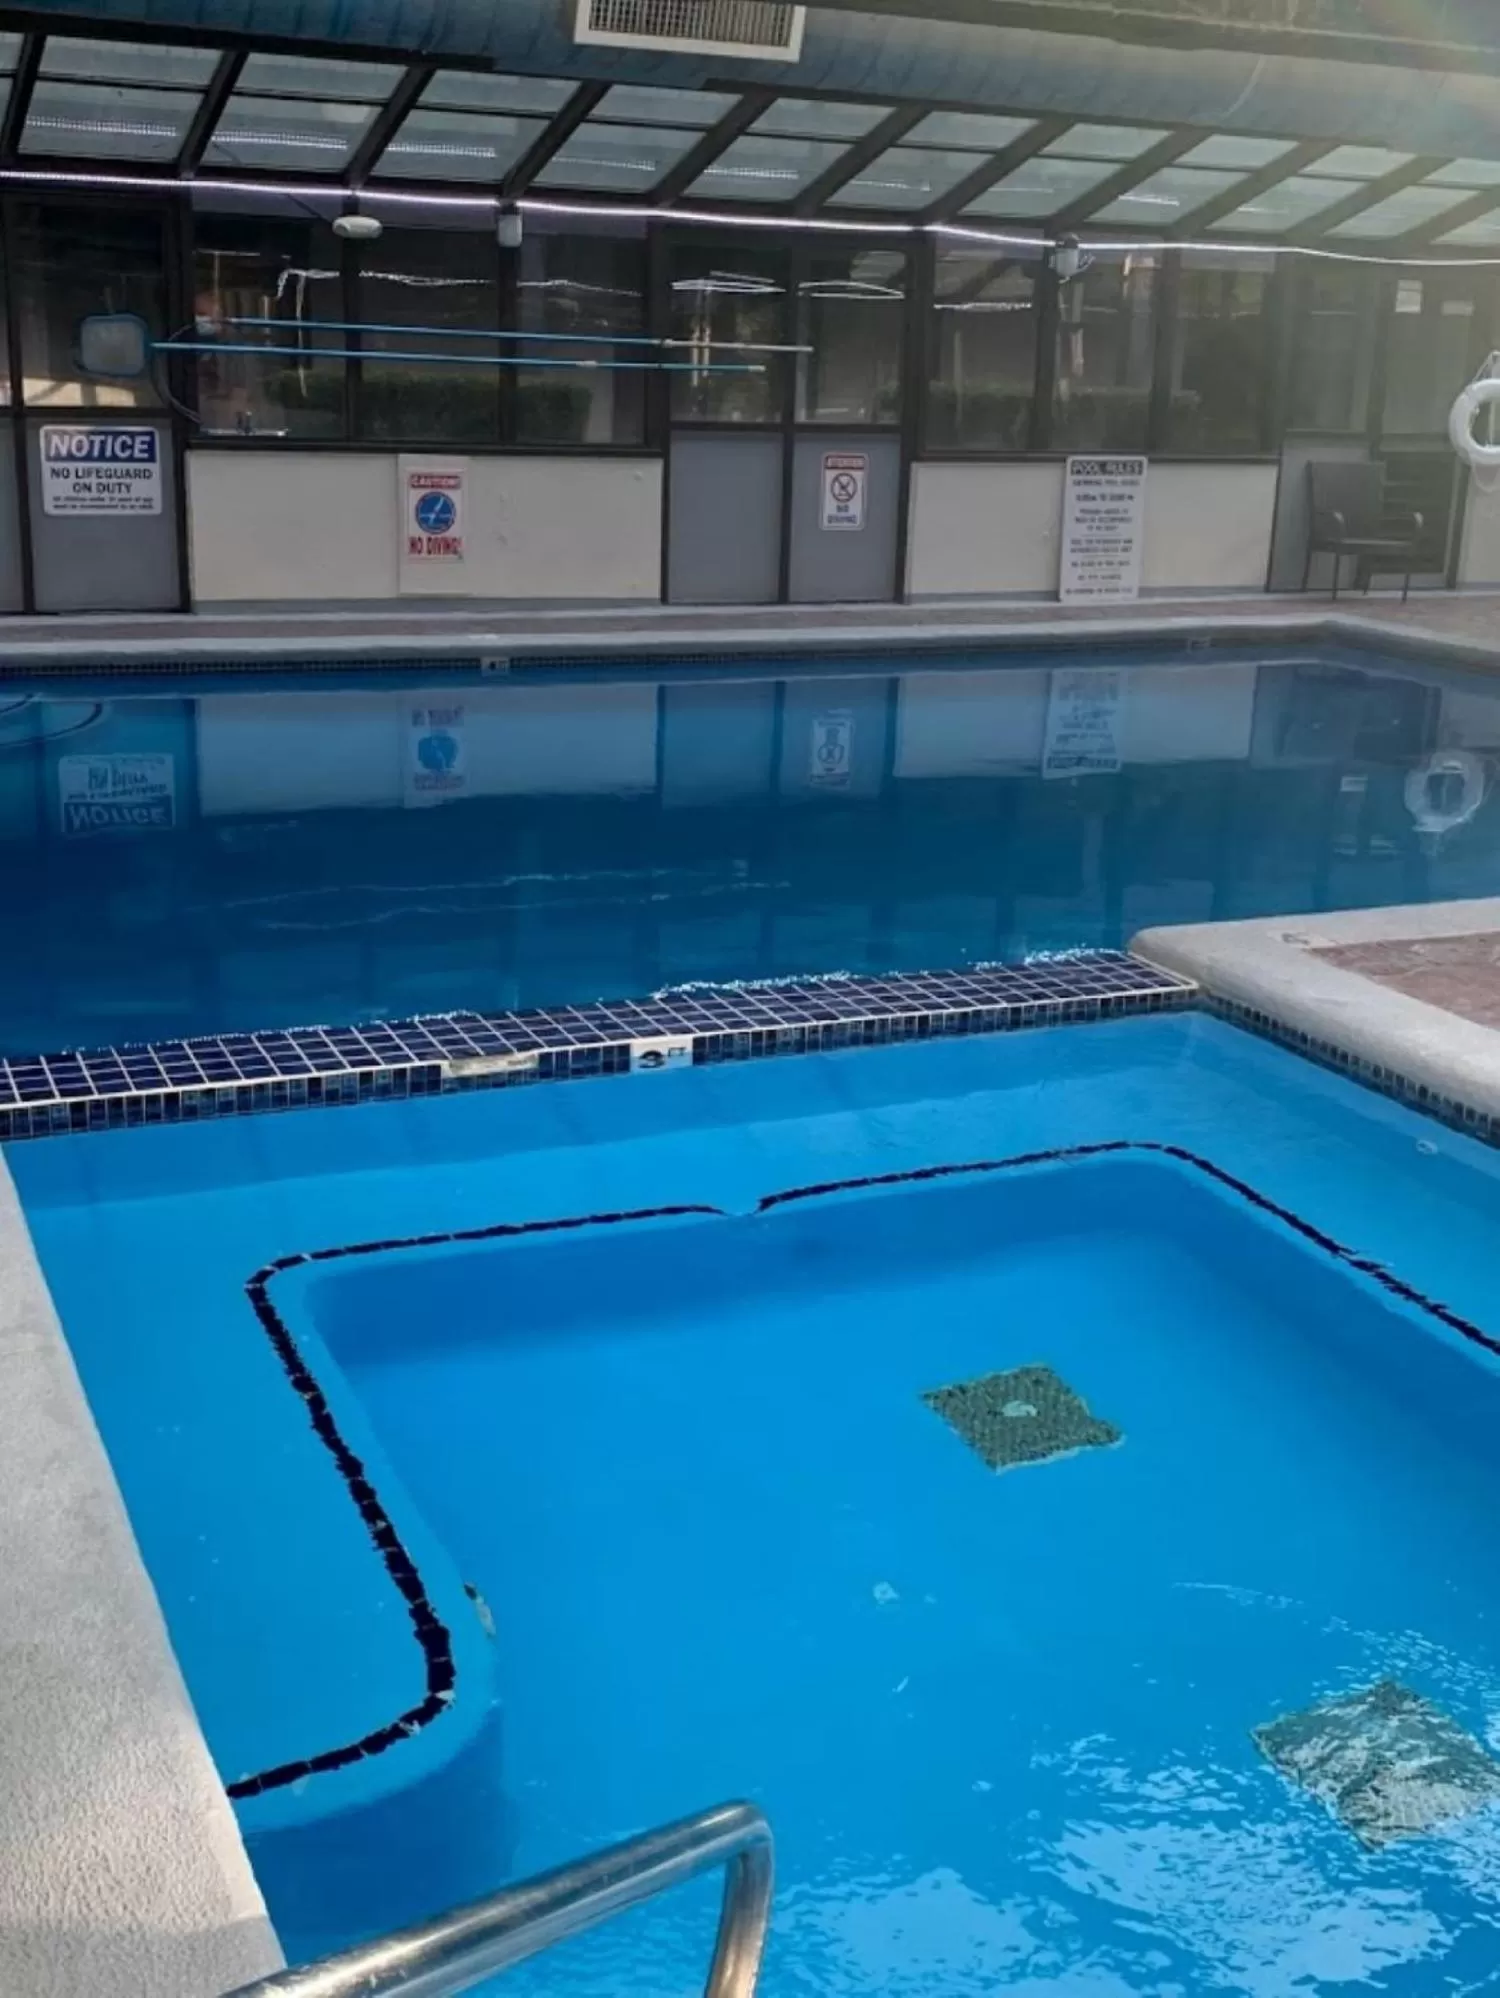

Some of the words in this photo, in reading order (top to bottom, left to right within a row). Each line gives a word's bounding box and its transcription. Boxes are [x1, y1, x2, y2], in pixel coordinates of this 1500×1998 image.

[50, 434, 152, 458] NOTICE
[50, 467, 71, 479] NO
[75, 467, 154, 479] LIFEGUARD
[73, 482, 93, 493] ON
[96, 482, 132, 493] DUTY
[409, 536, 424, 554] NO
